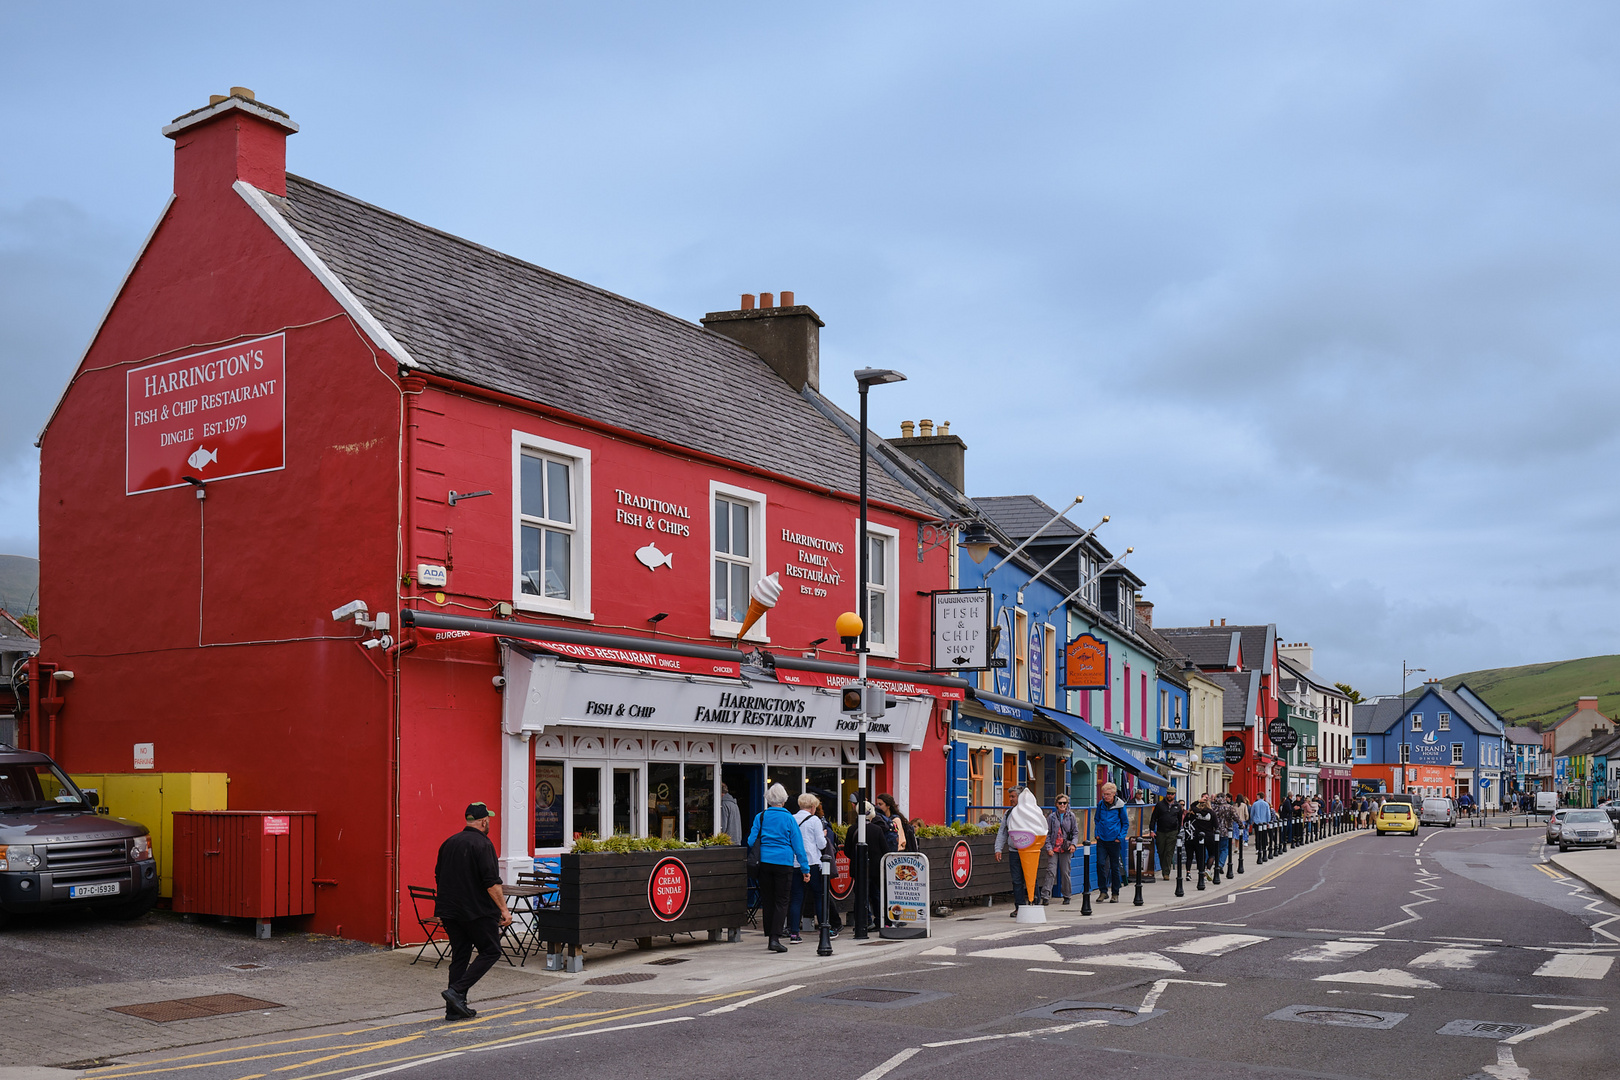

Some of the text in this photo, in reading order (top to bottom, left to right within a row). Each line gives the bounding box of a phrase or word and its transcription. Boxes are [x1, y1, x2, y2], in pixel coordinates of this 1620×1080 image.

[144, 350, 264, 398] HARRINGTON'S
[134, 380, 276, 426] FISH & CHIP RESTAURANT
[160, 428, 194, 447] DINGLE
[615, 489, 690, 519] TRADITIONAL
[616, 508, 690, 537] FISH & CHIPS
[782, 528, 844, 554] HARRINGTON'S
[799, 550, 828, 567] FAMILY
[424, 569, 444, 577] ADA
[786, 563, 839, 585] RESTAURANT
[800, 585, 827, 597] EST. 1979
[938, 596, 984, 604] HARRINGTON'S
[944, 607, 978, 619] FISH
[436, 630, 470, 640] BURGERS
[942, 630, 979, 641] CHIP
[946, 645, 975, 654] SHOP
[594, 648, 658, 666] RESTAURANT
[659, 658, 680, 668] DINGLE
[713, 666, 733, 674] CHICKEN
[586, 701, 656, 718] FISH & CHIP
[719, 692, 805, 713] HARRINGTON'S
[694, 706, 816, 728] FAMILY RESTAURANT
[836, 720, 891, 732] FOOD DRINK
[984, 721, 1054, 743] JOHN BENNY'S PUB
[665, 867, 675, 875] ICE
[887, 857, 925, 871] HARRINGTON'S
[658, 876, 680, 885] CREAM
[657, 886, 682, 895] SUNDAE
